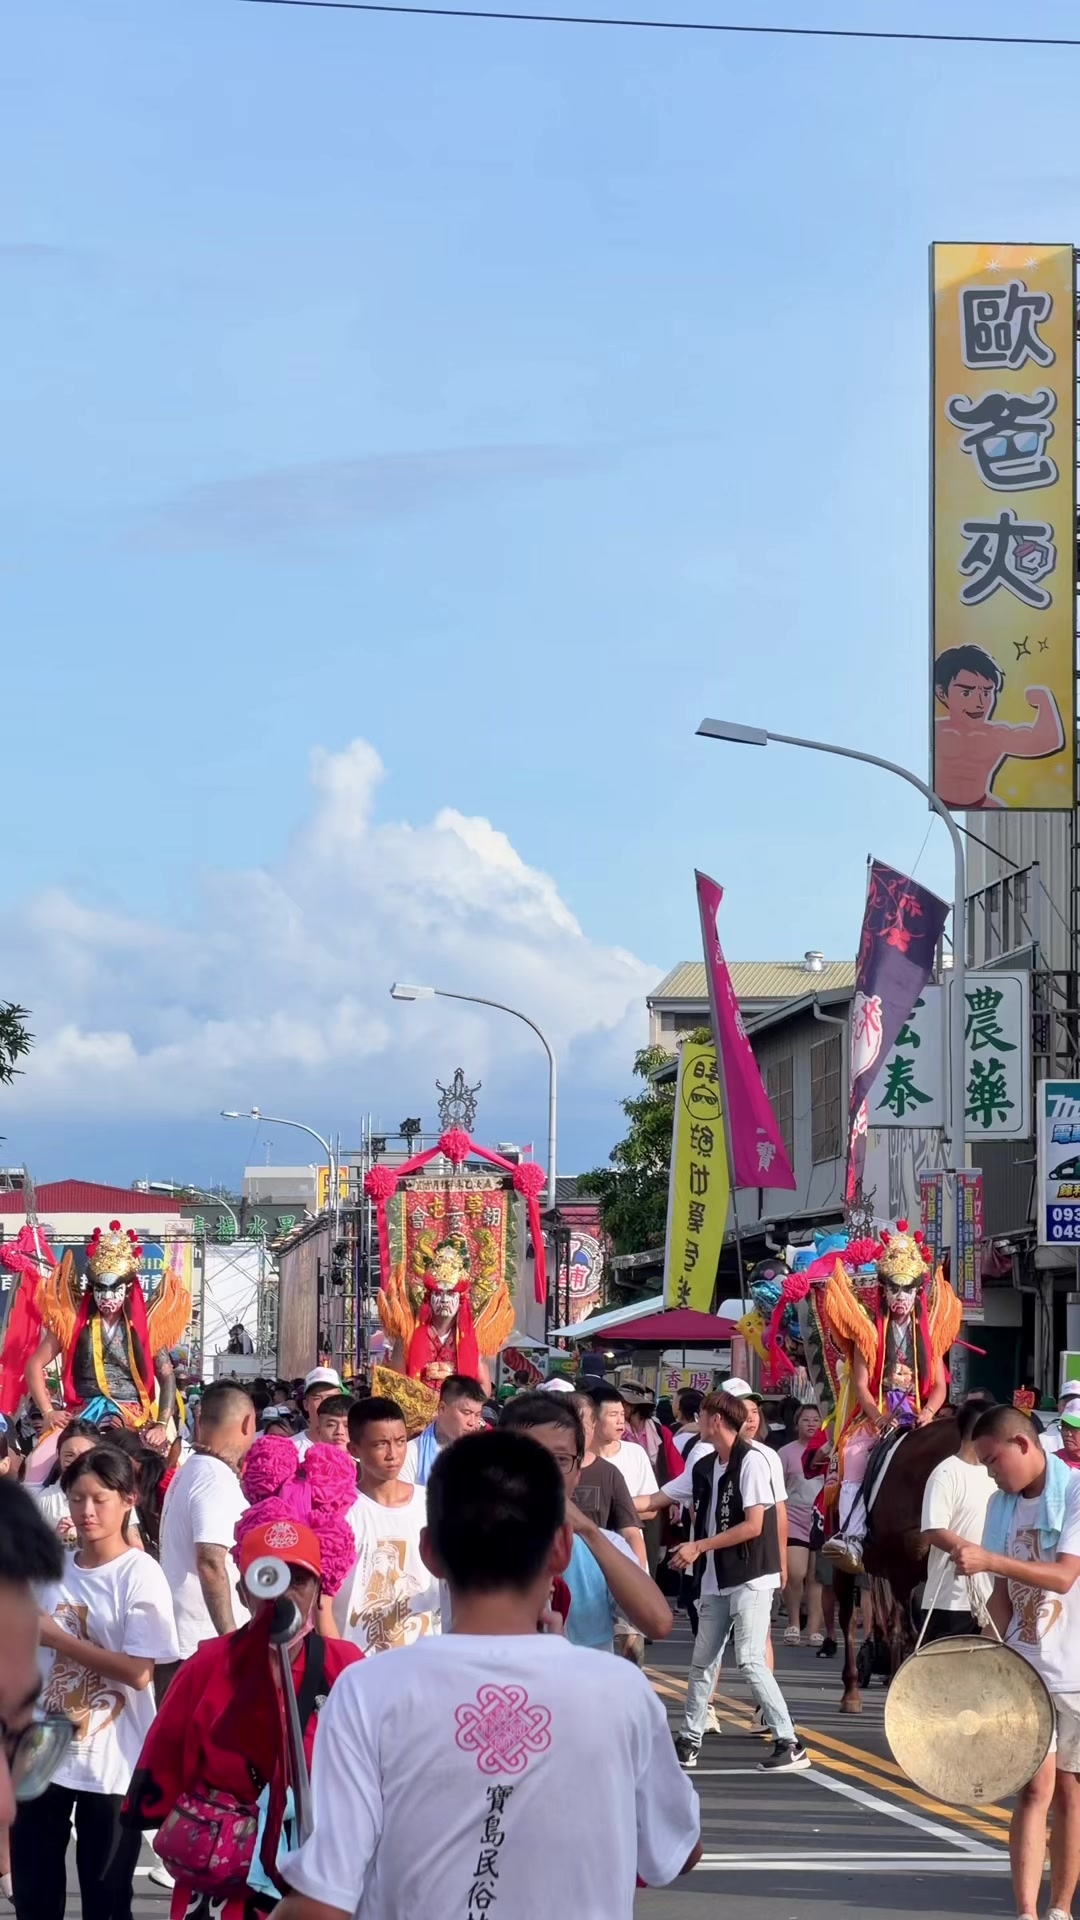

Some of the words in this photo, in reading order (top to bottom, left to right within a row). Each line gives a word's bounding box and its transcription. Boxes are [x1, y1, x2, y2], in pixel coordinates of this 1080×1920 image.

[945, 279, 1058, 610] 歐爸夾
[964, 985, 1018, 1129] 農藥
[664, 1370, 711, 1391] 香腸
[466, 1784, 514, 1920] 寶島民俗
